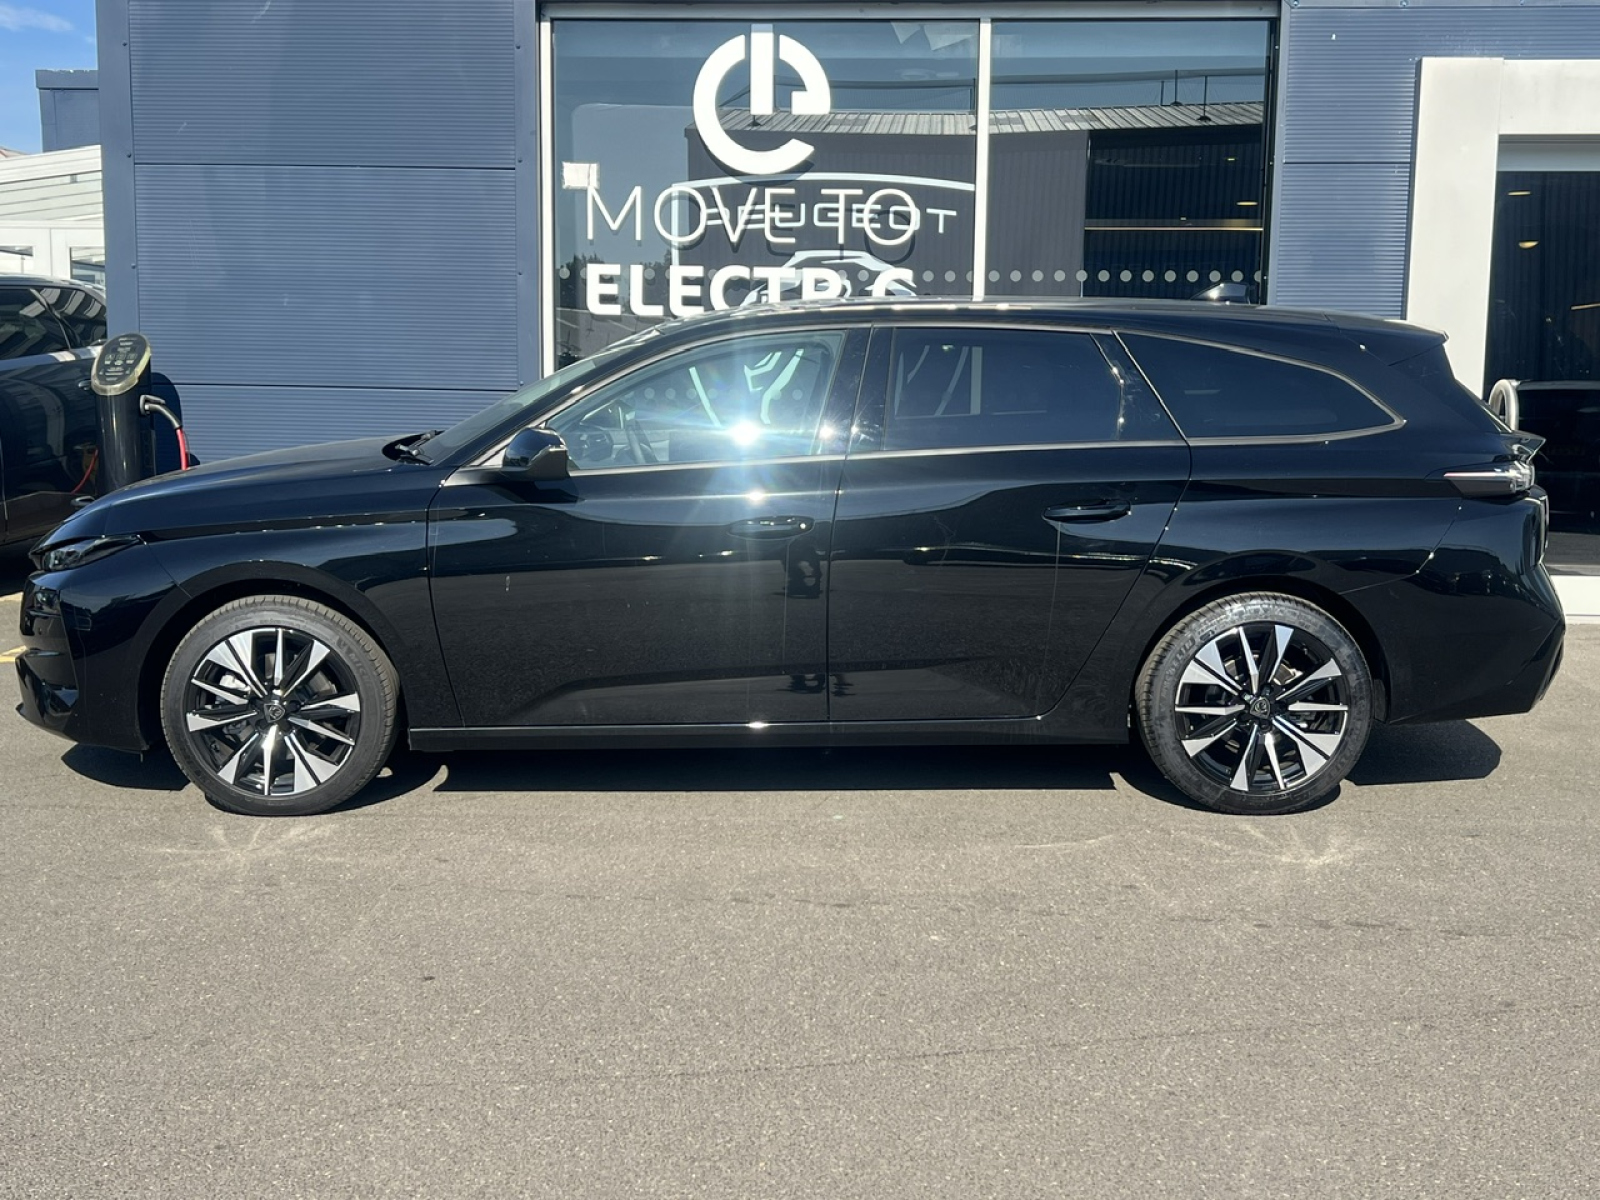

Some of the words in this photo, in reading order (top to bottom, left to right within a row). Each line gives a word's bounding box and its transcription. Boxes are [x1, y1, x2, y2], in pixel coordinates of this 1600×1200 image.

[586, 185, 796, 243] MOVE
[820, 187, 917, 246] TO
[586, 263, 915, 318] ELECTRC
